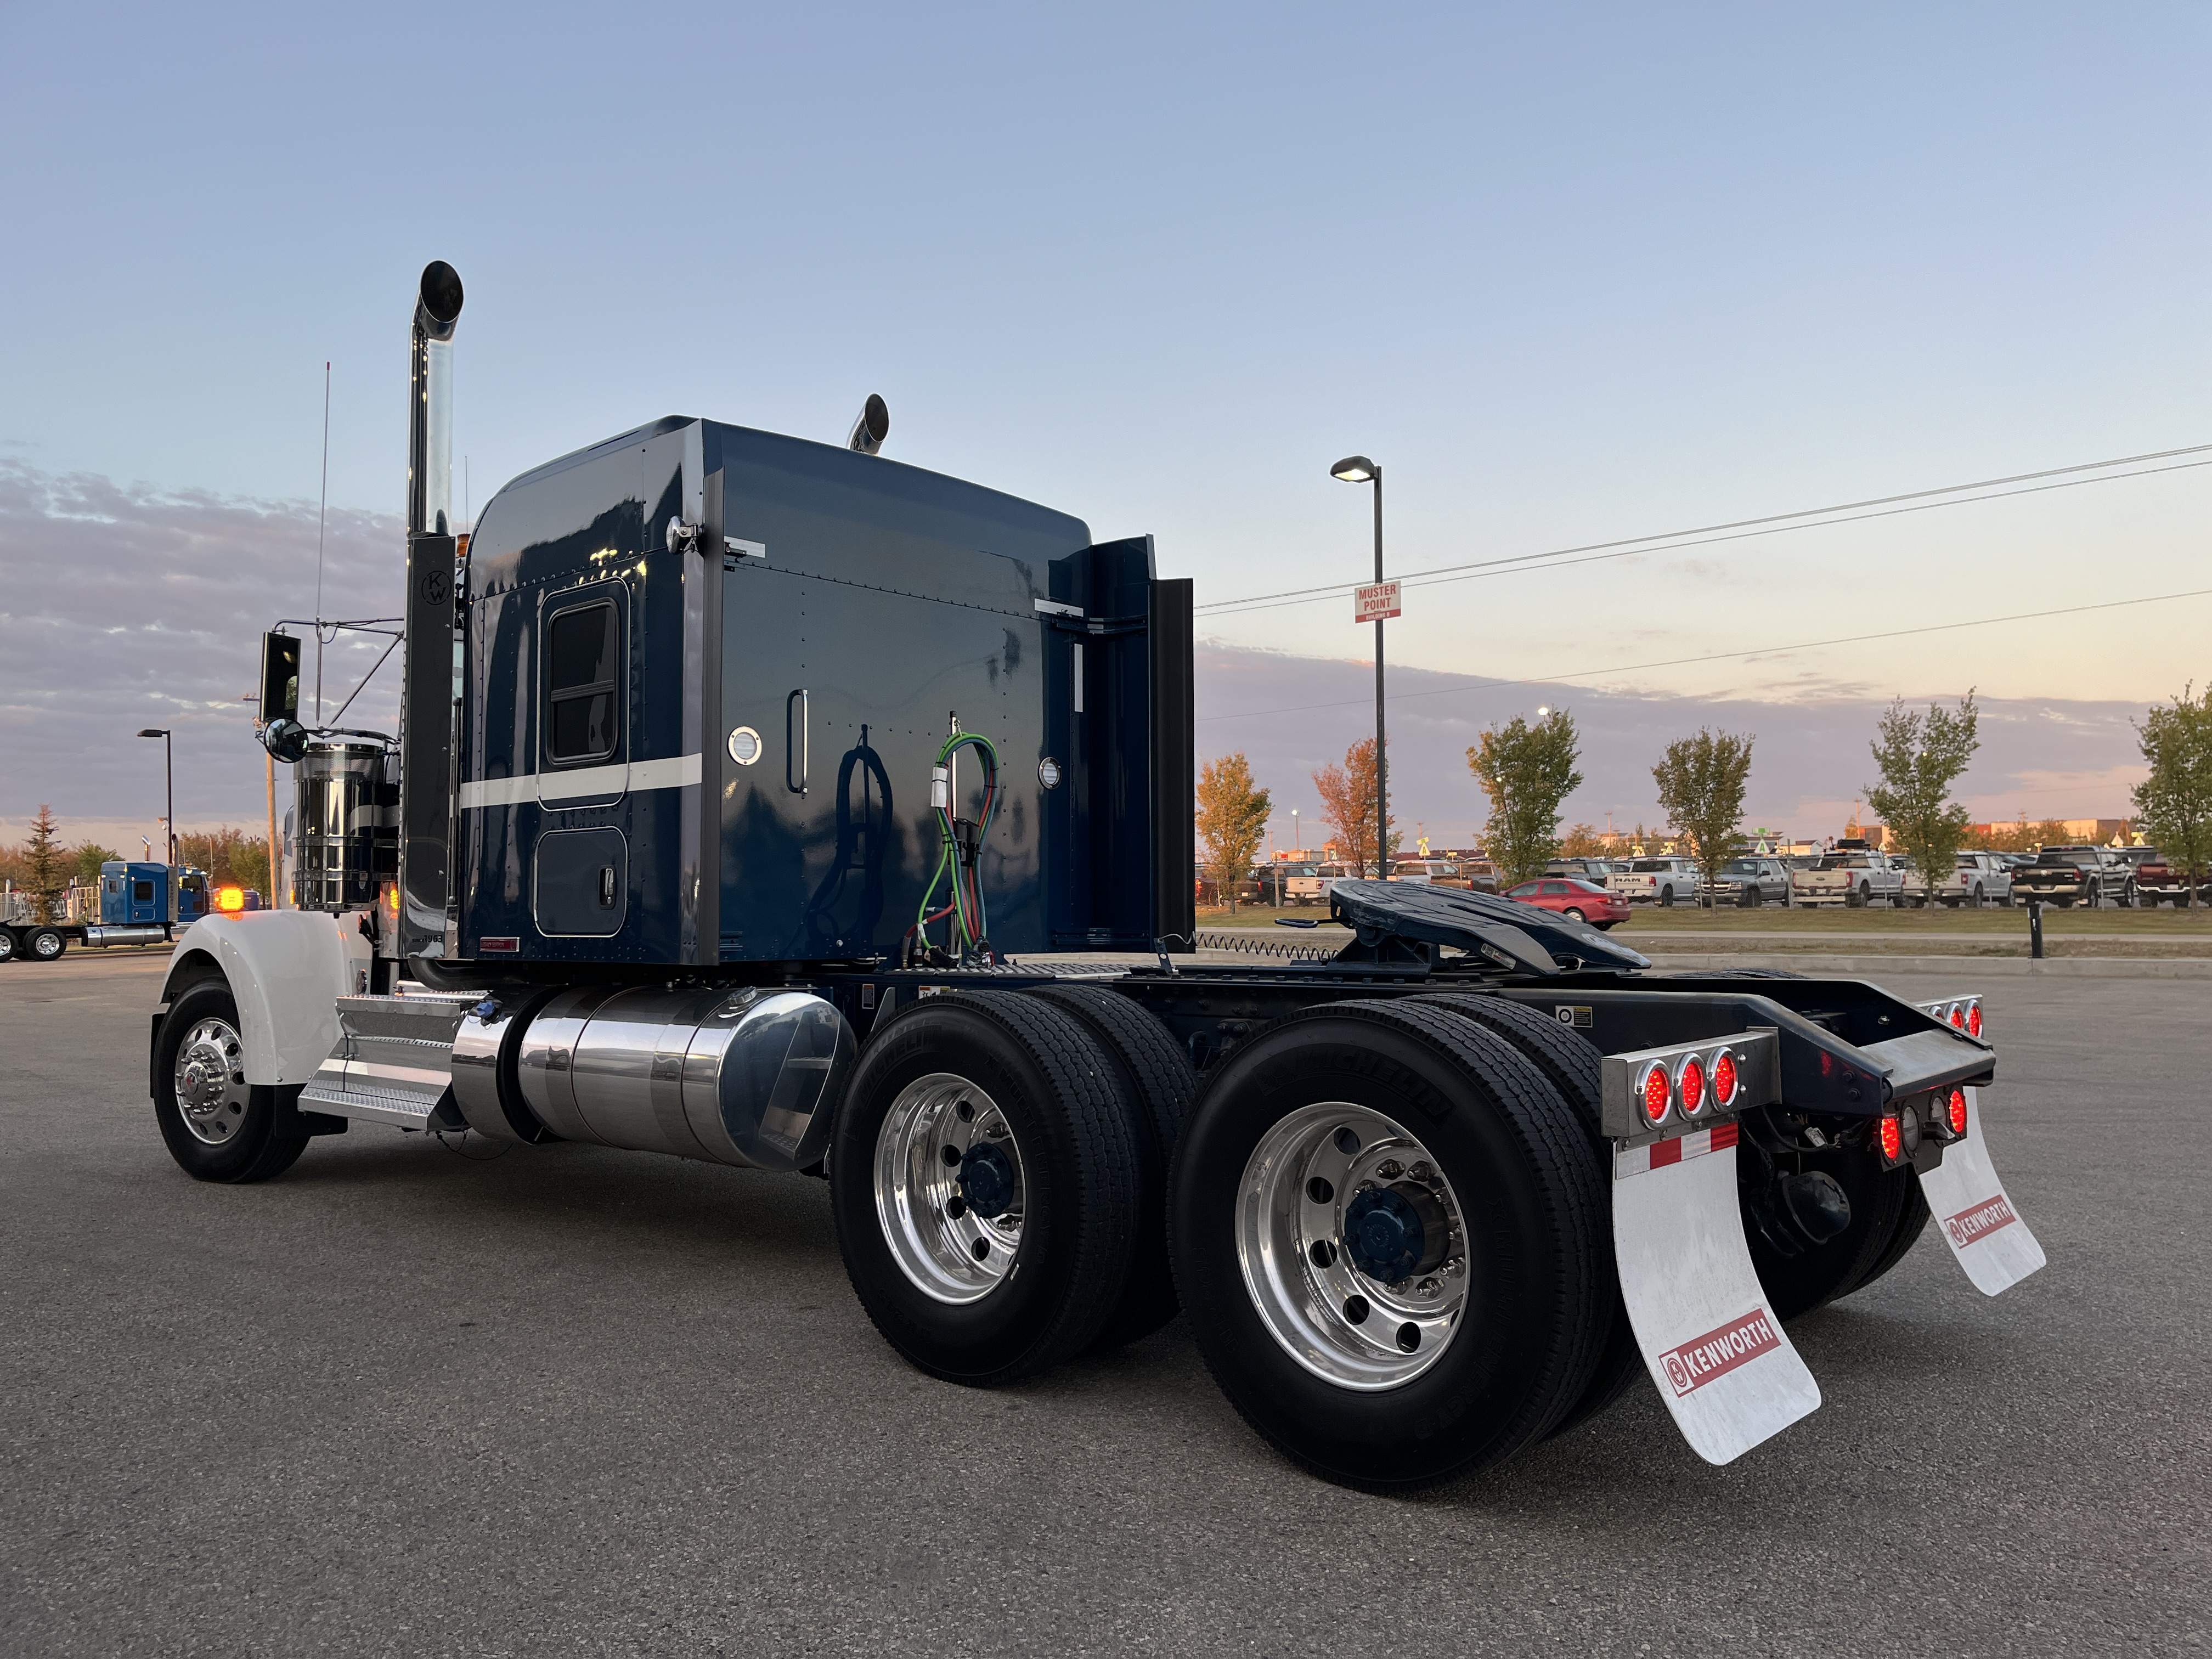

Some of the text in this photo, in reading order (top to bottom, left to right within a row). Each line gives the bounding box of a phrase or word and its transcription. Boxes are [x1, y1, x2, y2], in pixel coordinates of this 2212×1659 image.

[428, 573, 442, 589] K
[430, 587, 447, 602] W
[1359, 584, 1396, 600] MUSTER
[1364, 597, 1391, 611] POINT
[1759, 843, 1765, 852] A
[424, 934, 443, 943] 1963
[1295, 1051, 1451, 1116] MICHELIN
[1957, 1200, 2011, 1238] KENWORTH
[1683, 1318, 1773, 1378] KENWORTH
[1671, 1363, 1679, 1373] K
[1674, 1372, 1683, 1383] W
